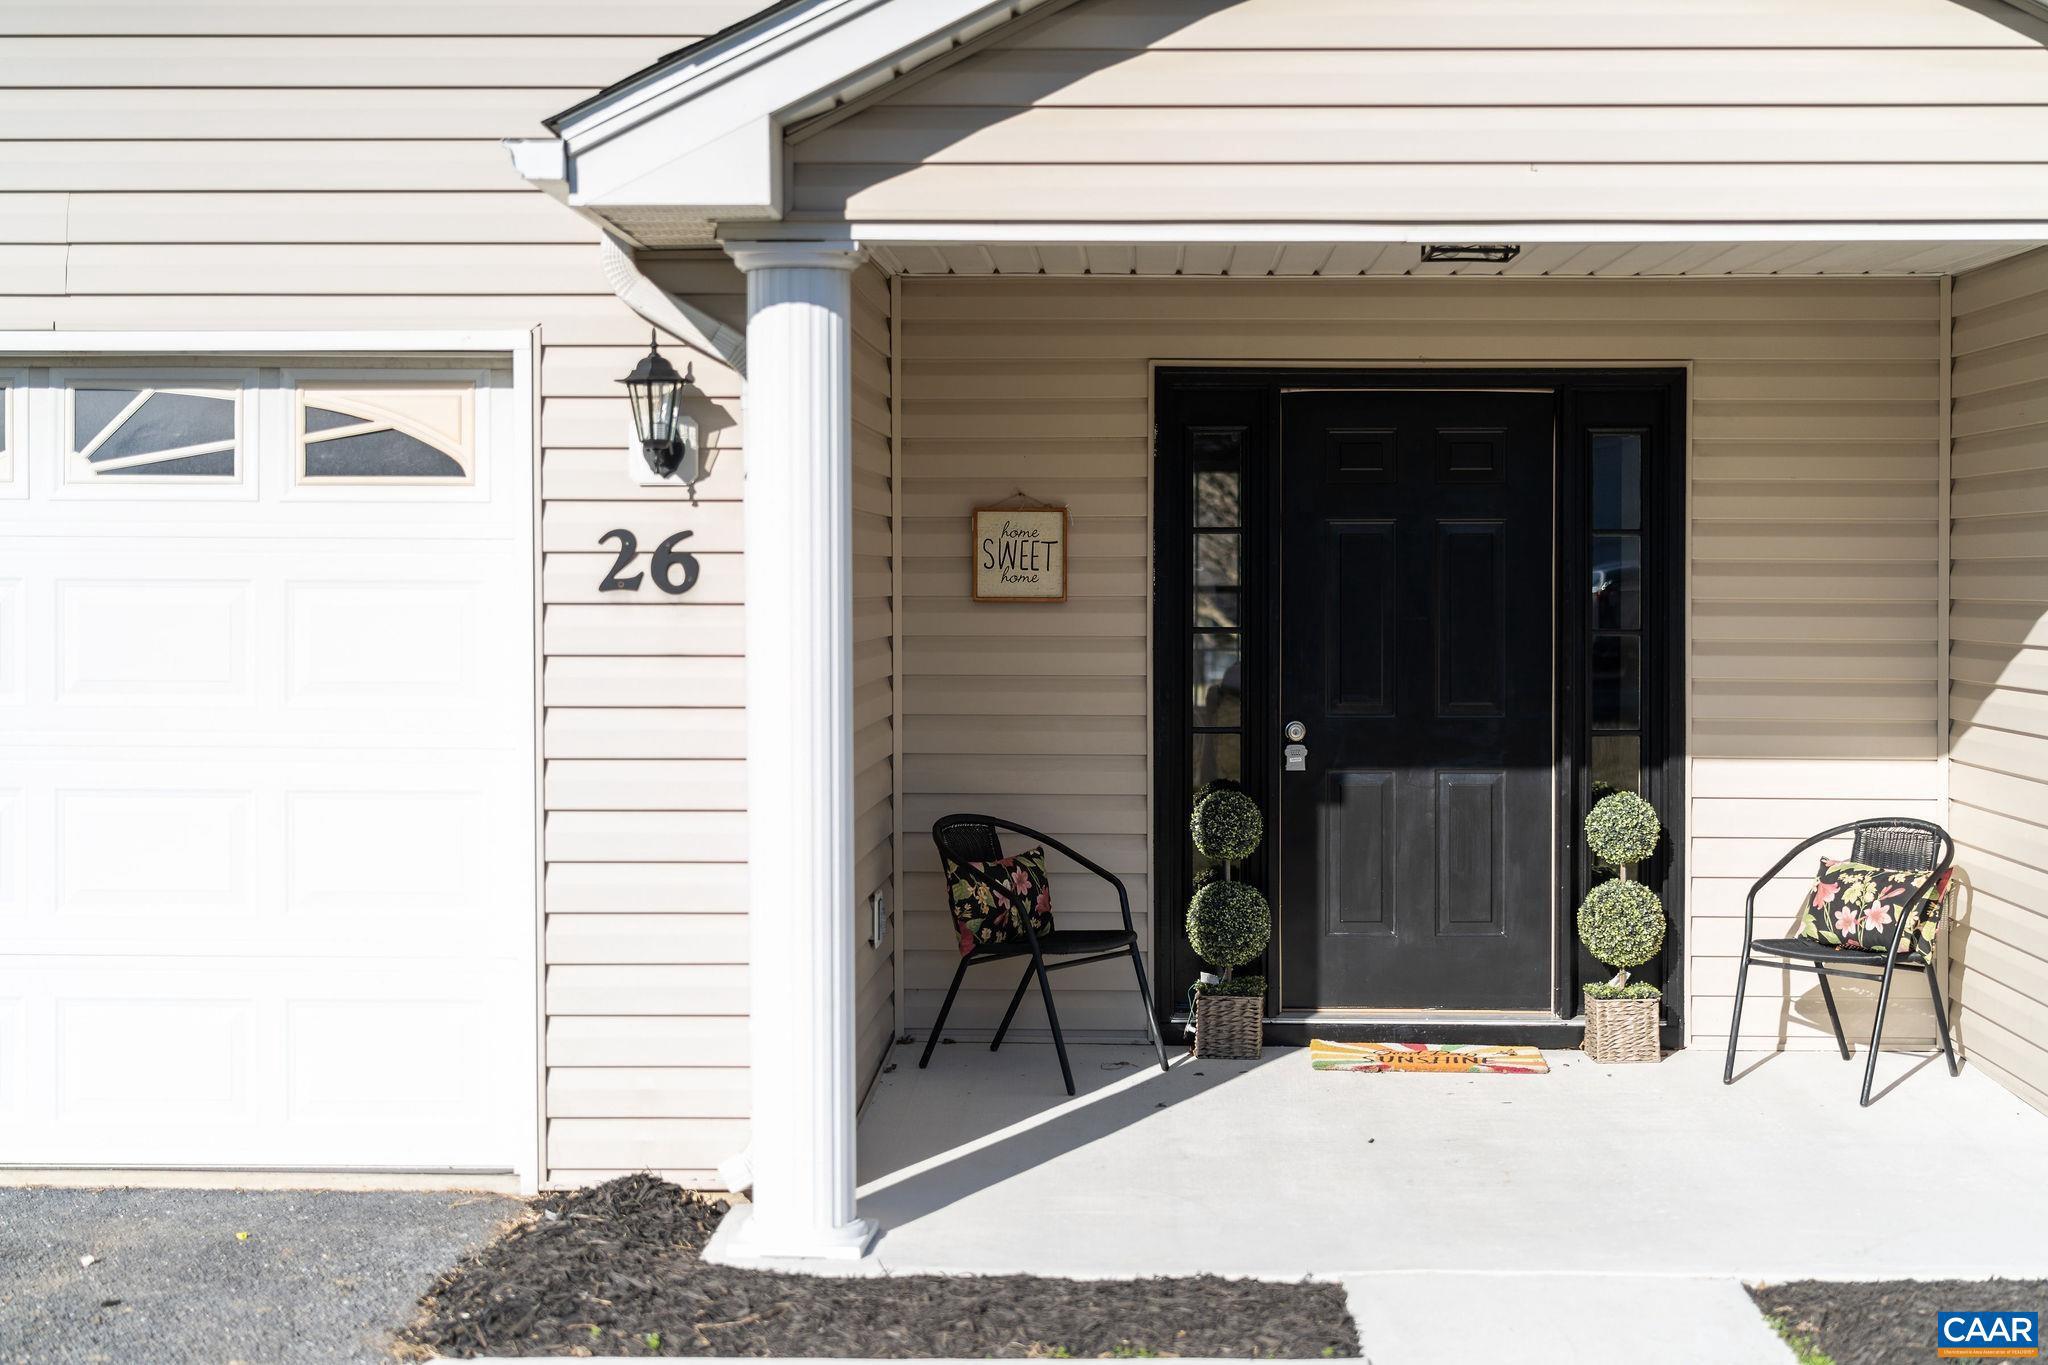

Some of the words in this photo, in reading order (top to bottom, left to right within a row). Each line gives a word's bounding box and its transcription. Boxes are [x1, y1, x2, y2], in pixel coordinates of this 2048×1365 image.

[1000, 520, 1040, 538] home
[598, 528, 700, 595] 26
[982, 538, 1058, 571] SWEET
[1000, 565, 1040, 584] home
[1362, 1055, 1492, 1064] SUNSHINE
